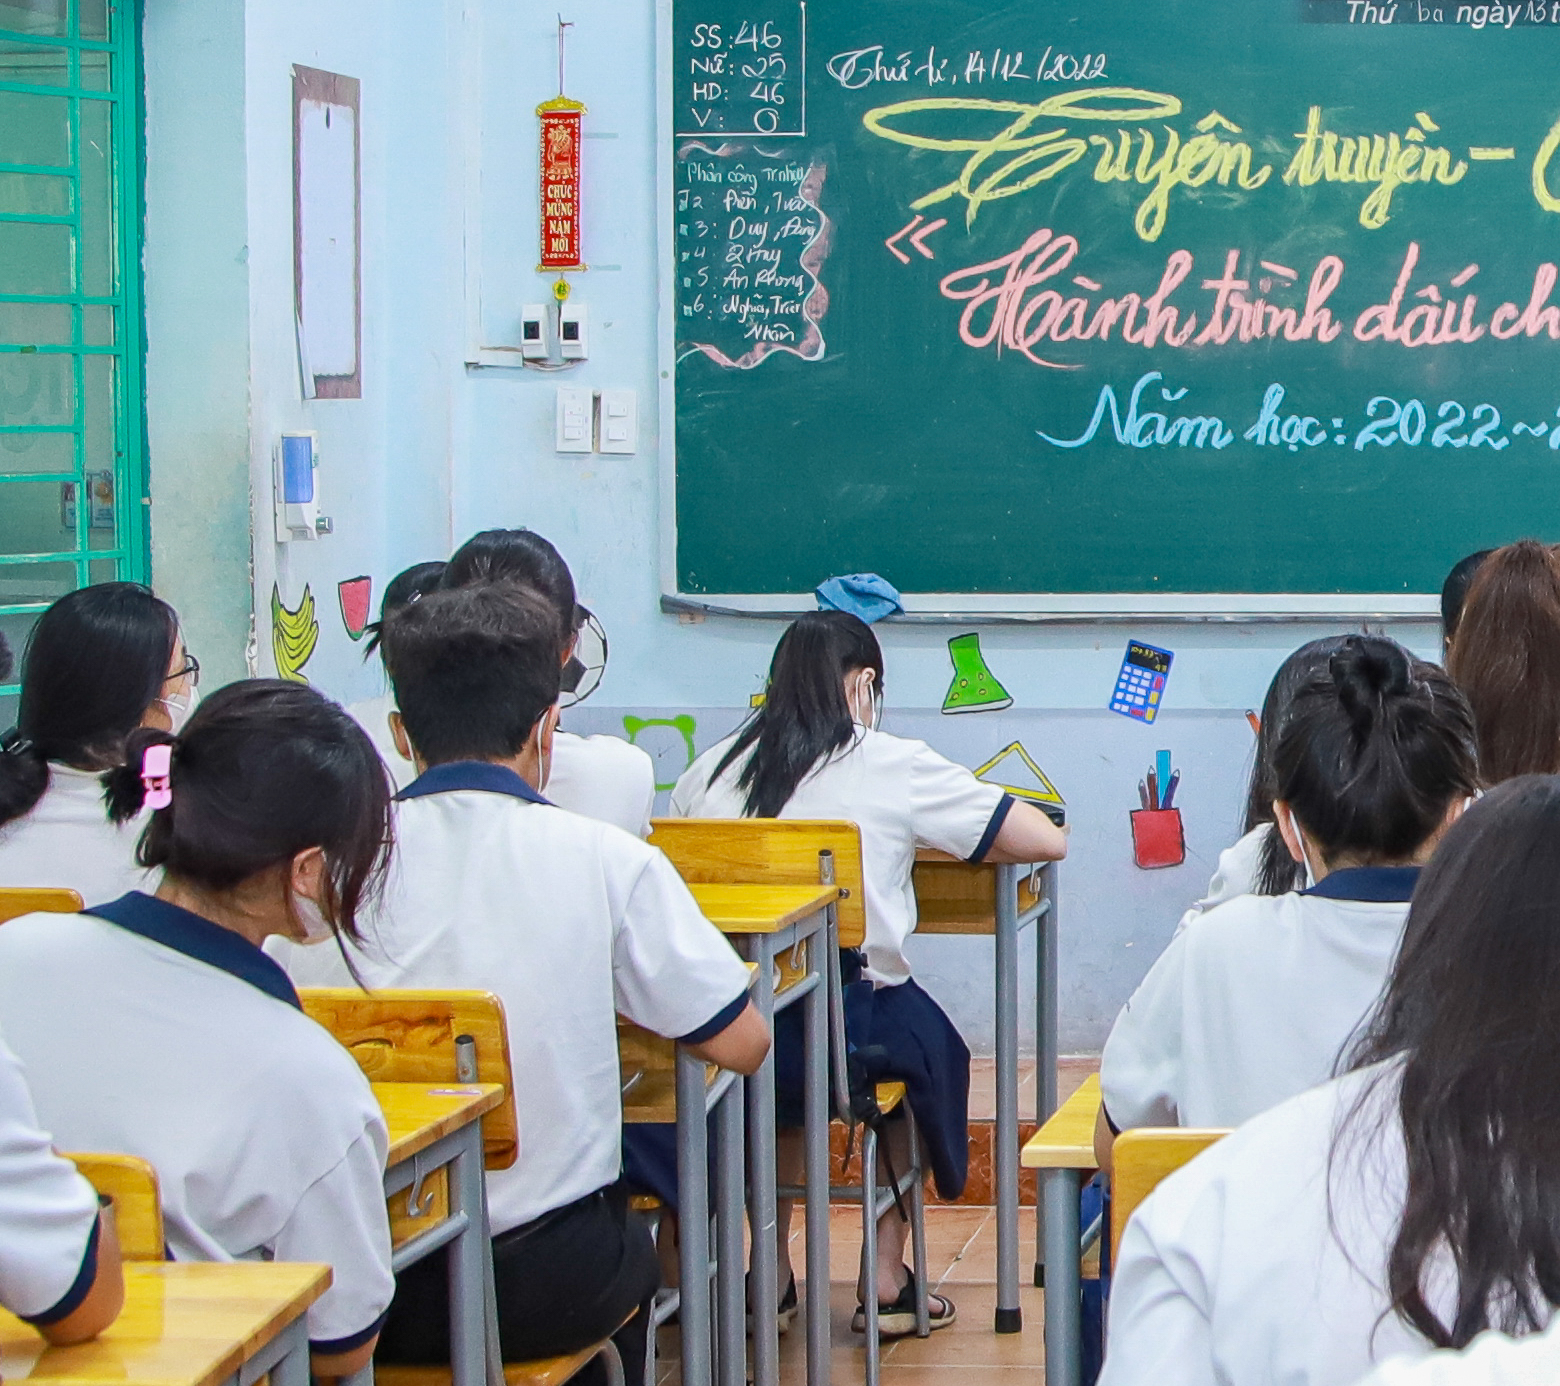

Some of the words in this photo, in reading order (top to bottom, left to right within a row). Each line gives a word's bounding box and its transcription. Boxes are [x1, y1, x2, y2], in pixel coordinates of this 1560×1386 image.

[1346, 0, 1399, 24] Thứ
[1457, 1, 1521, 29] ngày
[1193, 250, 1345, 346] trình
[1036, 371, 1234, 450] Năm
